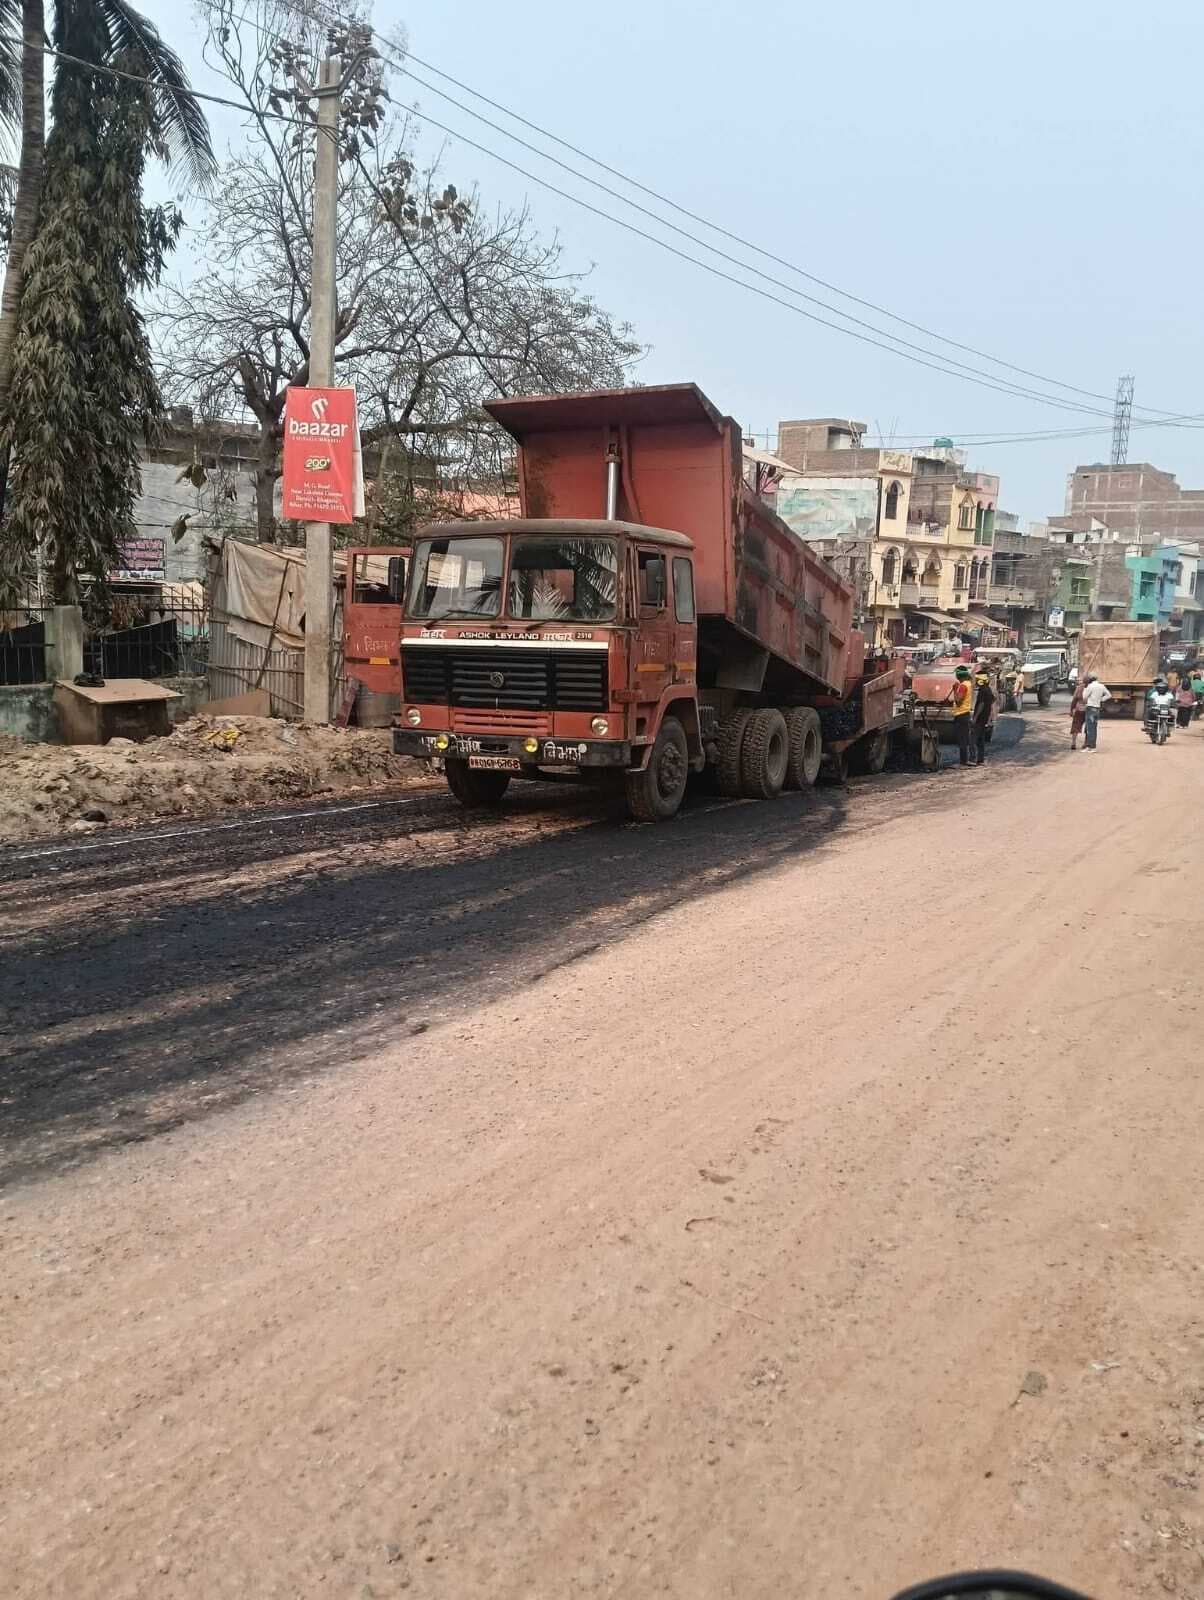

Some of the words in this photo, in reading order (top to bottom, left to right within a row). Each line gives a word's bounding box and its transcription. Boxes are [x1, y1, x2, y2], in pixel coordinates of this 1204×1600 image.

[289, 417, 349, 437] baazar
[459, 631, 490, 639] ASHOK
[495, 632, 539, 640] LEYLAND
